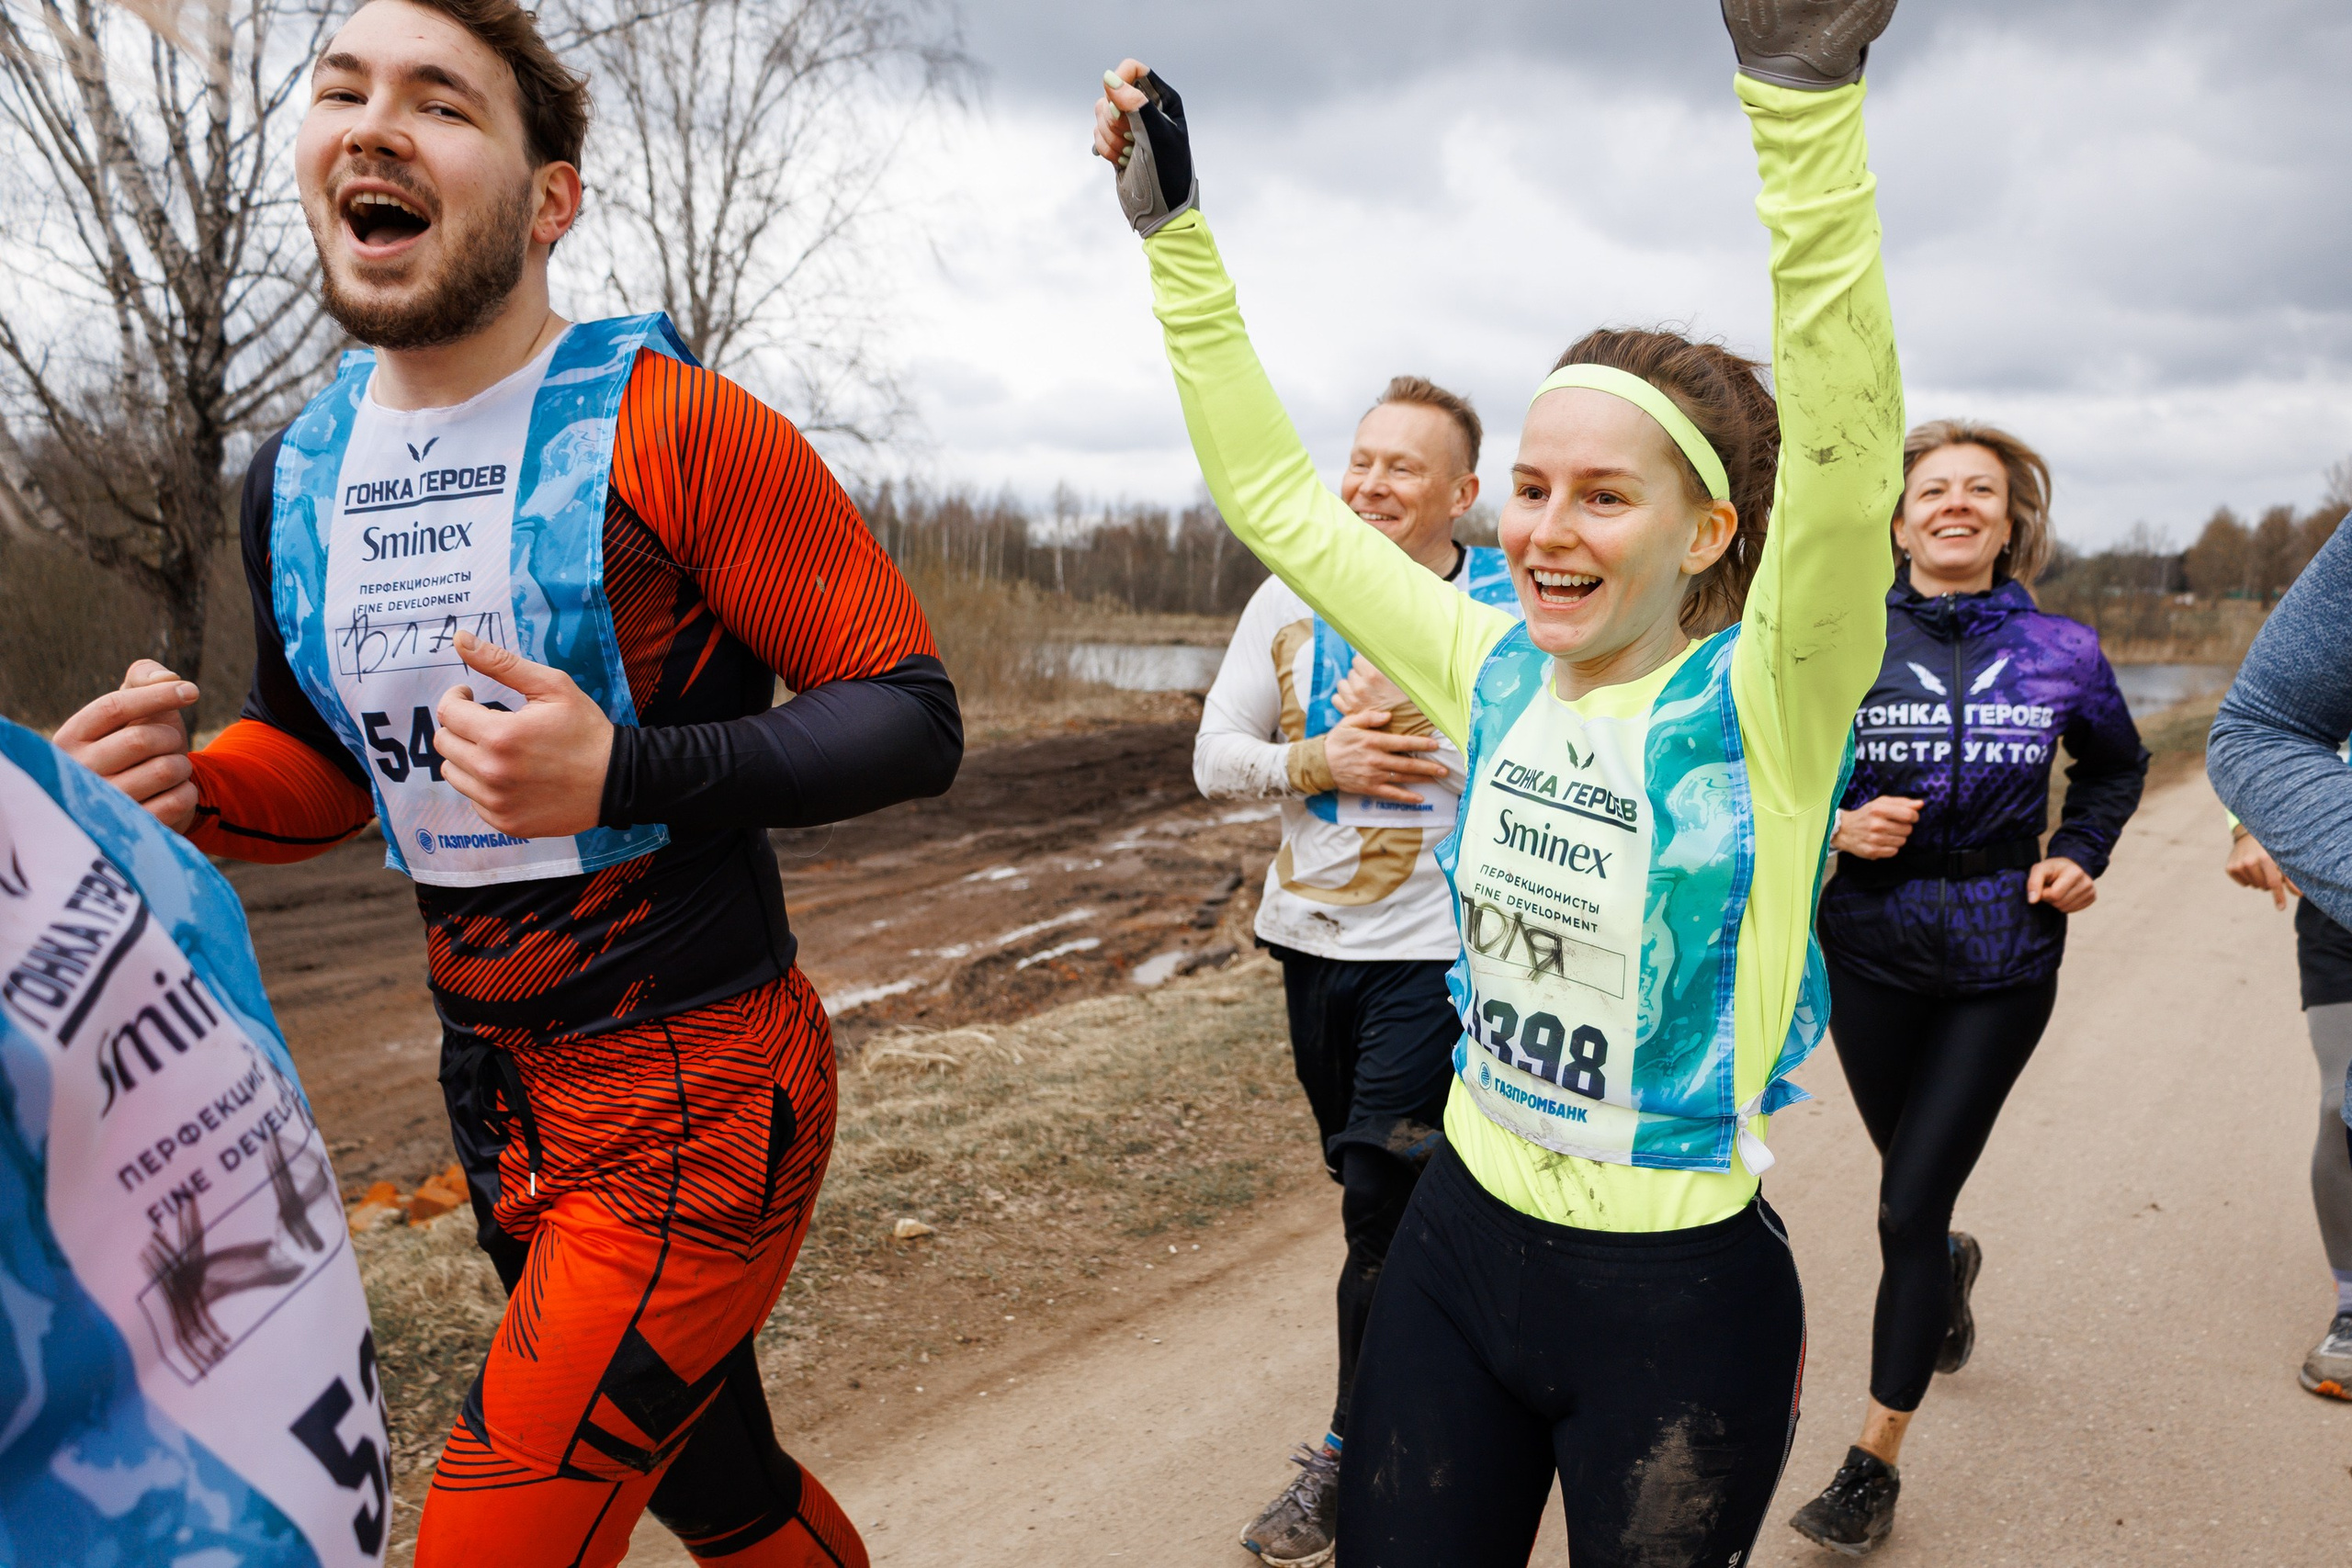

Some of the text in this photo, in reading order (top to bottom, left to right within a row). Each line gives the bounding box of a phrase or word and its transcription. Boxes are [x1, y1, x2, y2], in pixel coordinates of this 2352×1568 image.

[345, 464, 507, 506] ГОНКА ГЕРОЕВ
[362, 520, 473, 563] Sminex
[357, 591, 471, 615] FINE DEVELOPMENT
[359, 570, 472, 595] ПЕРФЕКЦИОНИСТЫ
[1855, 703, 2054, 728] ГОНКА ГЕРОЕВ
[1493, 759, 1639, 823] ГОНКА ГЕРОЕВ
[1493, 807, 1612, 880] Sminex
[1474, 883, 1599, 933] FINE DEVELOPMENT
[1479, 863, 1600, 915] ПЕРФЕКЦИОНИСТЫ
[3, 921, 111, 1032] ГОНКА
[1494, 1077, 1589, 1123] ГАЗПРОМБАНК
[146, 1168, 212, 1227] FINE
